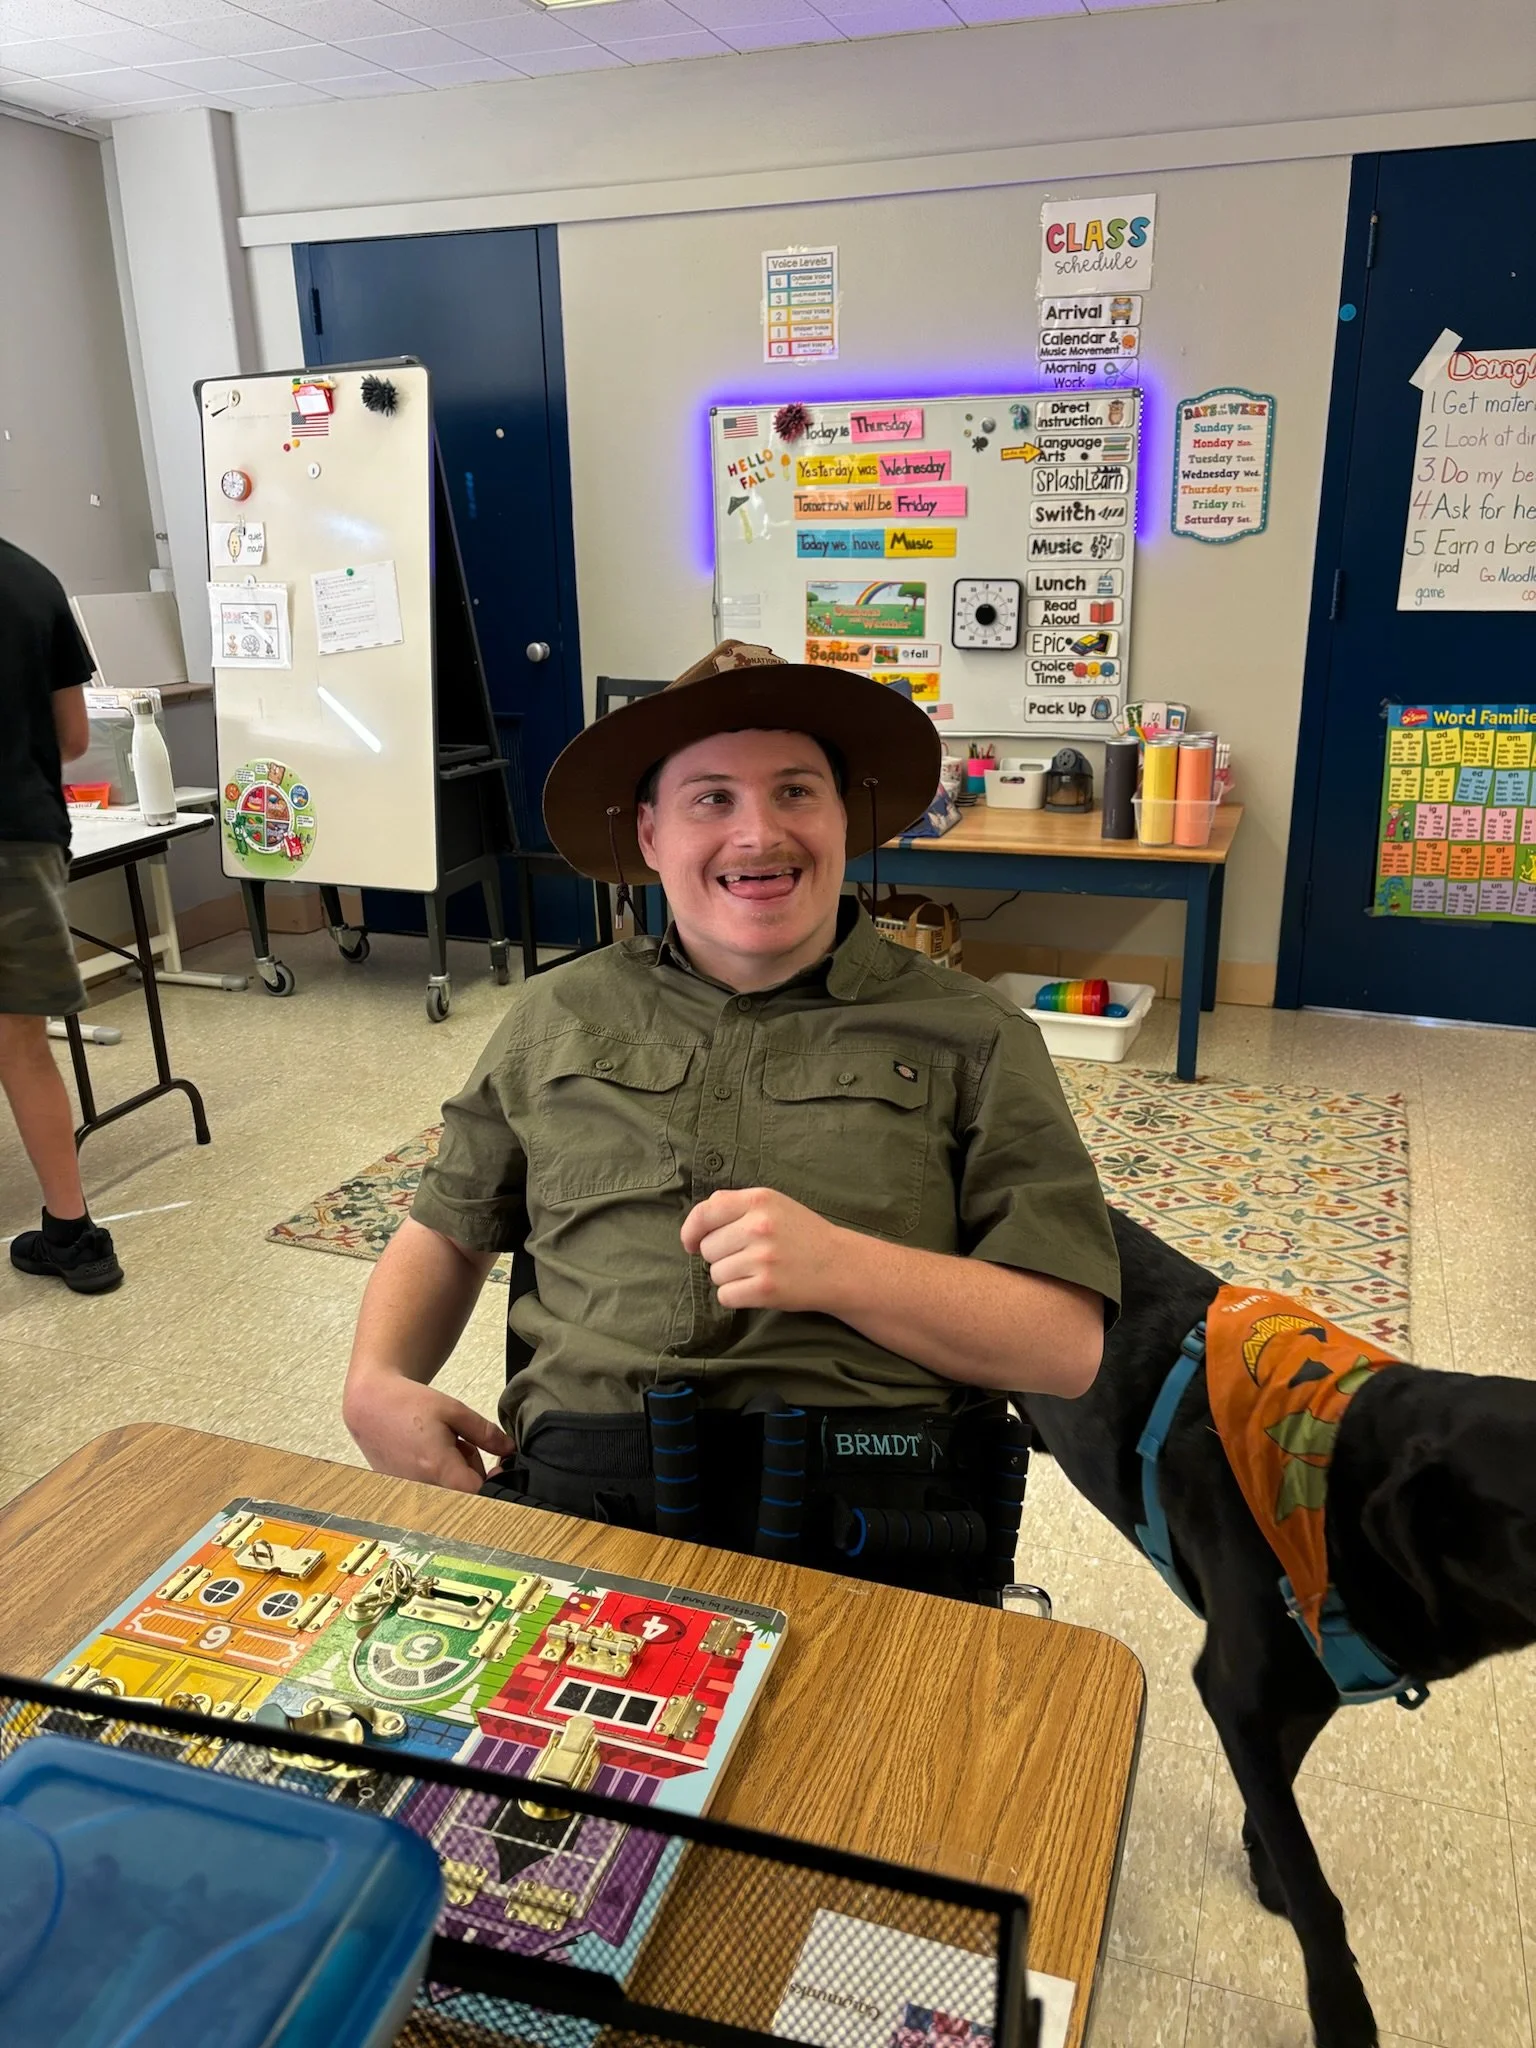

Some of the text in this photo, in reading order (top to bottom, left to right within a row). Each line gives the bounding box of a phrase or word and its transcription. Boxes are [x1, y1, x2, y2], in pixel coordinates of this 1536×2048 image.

[1046, 216, 1151, 253] CLASS
[772, 257, 828, 269] Voice Levels
[1054, 252, 1138, 275] schedule
[775, 295, 782, 304] 3
[775, 312, 782, 321] 2
[1045, 304, 1102, 320] Arrival
[1042, 331, 1119, 346] Calendar &
[776, 345, 783, 354] 0
[1040, 345, 1120, 357] Music Movement
[1045, 362, 1096, 374] Morning
[1448, 352, 1528, 388] Doing
[1054, 377, 1085, 388] Work
[1051, 402, 1090, 414] Direct
[1228, 403, 1267, 416] WEEK
[1443, 390, 1480, 415] Get
[1485, 391, 1536, 413] mater
[1184, 404, 1218, 420] DAYS
[805, 414, 912, 444] Today is Thursday
[1194, 423, 1234, 435] Sunday
[1421, 424, 1439, 449] 2
[1444, 423, 1489, 448] Look
[1494, 425, 1514, 447] at
[1038, 437, 1102, 450] Language
[1192, 438, 1234, 450] Monday
[727, 449, 773, 477] HELLO
[1037, 452, 1066, 462] Arts
[1188, 453, 1233, 465] Tuesday
[740, 467, 774, 489] FALL
[798, 460, 945, 483] Yesterday was Wednesday
[1181, 469, 1240, 481] Wednesday
[1440, 456, 1468, 484] Do
[1477, 471, 1503, 490] my
[1511, 461, 1536, 483] be
[1181, 484, 1233, 496] Thursday
[794, 494, 937, 516] Tomorrow will be Friday
[1192, 499, 1228, 511] Friday
[1431, 492, 1472, 520] Ask
[1479, 492, 1506, 520] for
[1036, 505, 1095, 522] Switch
[1184, 514, 1234, 526] Saturday
[797, 533, 933, 557] Today we have Music
[1032, 539, 1082, 555] Music
[1433, 528, 1479, 555] Earn
[1484, 540, 1495, 554] a
[1480, 567, 1496, 582] Go
[1036, 576, 1086, 591] Lunch
[1415, 587, 1445, 606] game
[1044, 600, 1077, 611] Read
[1041, 614, 1080, 625] Aloud
[911, 649, 928, 659] fall
[1031, 661, 1075, 671] Choice
[1035, 674, 1066, 684] Time
[1029, 703, 1086, 717] Pack Up
[1433, 708, 1536, 726] Word Familie
[1499, 809, 1507, 818] ip
[835, 1433, 921, 1457] BRMDT
[709, 1600, 721, 1610] by
[641, 1615, 670, 1640] 4
